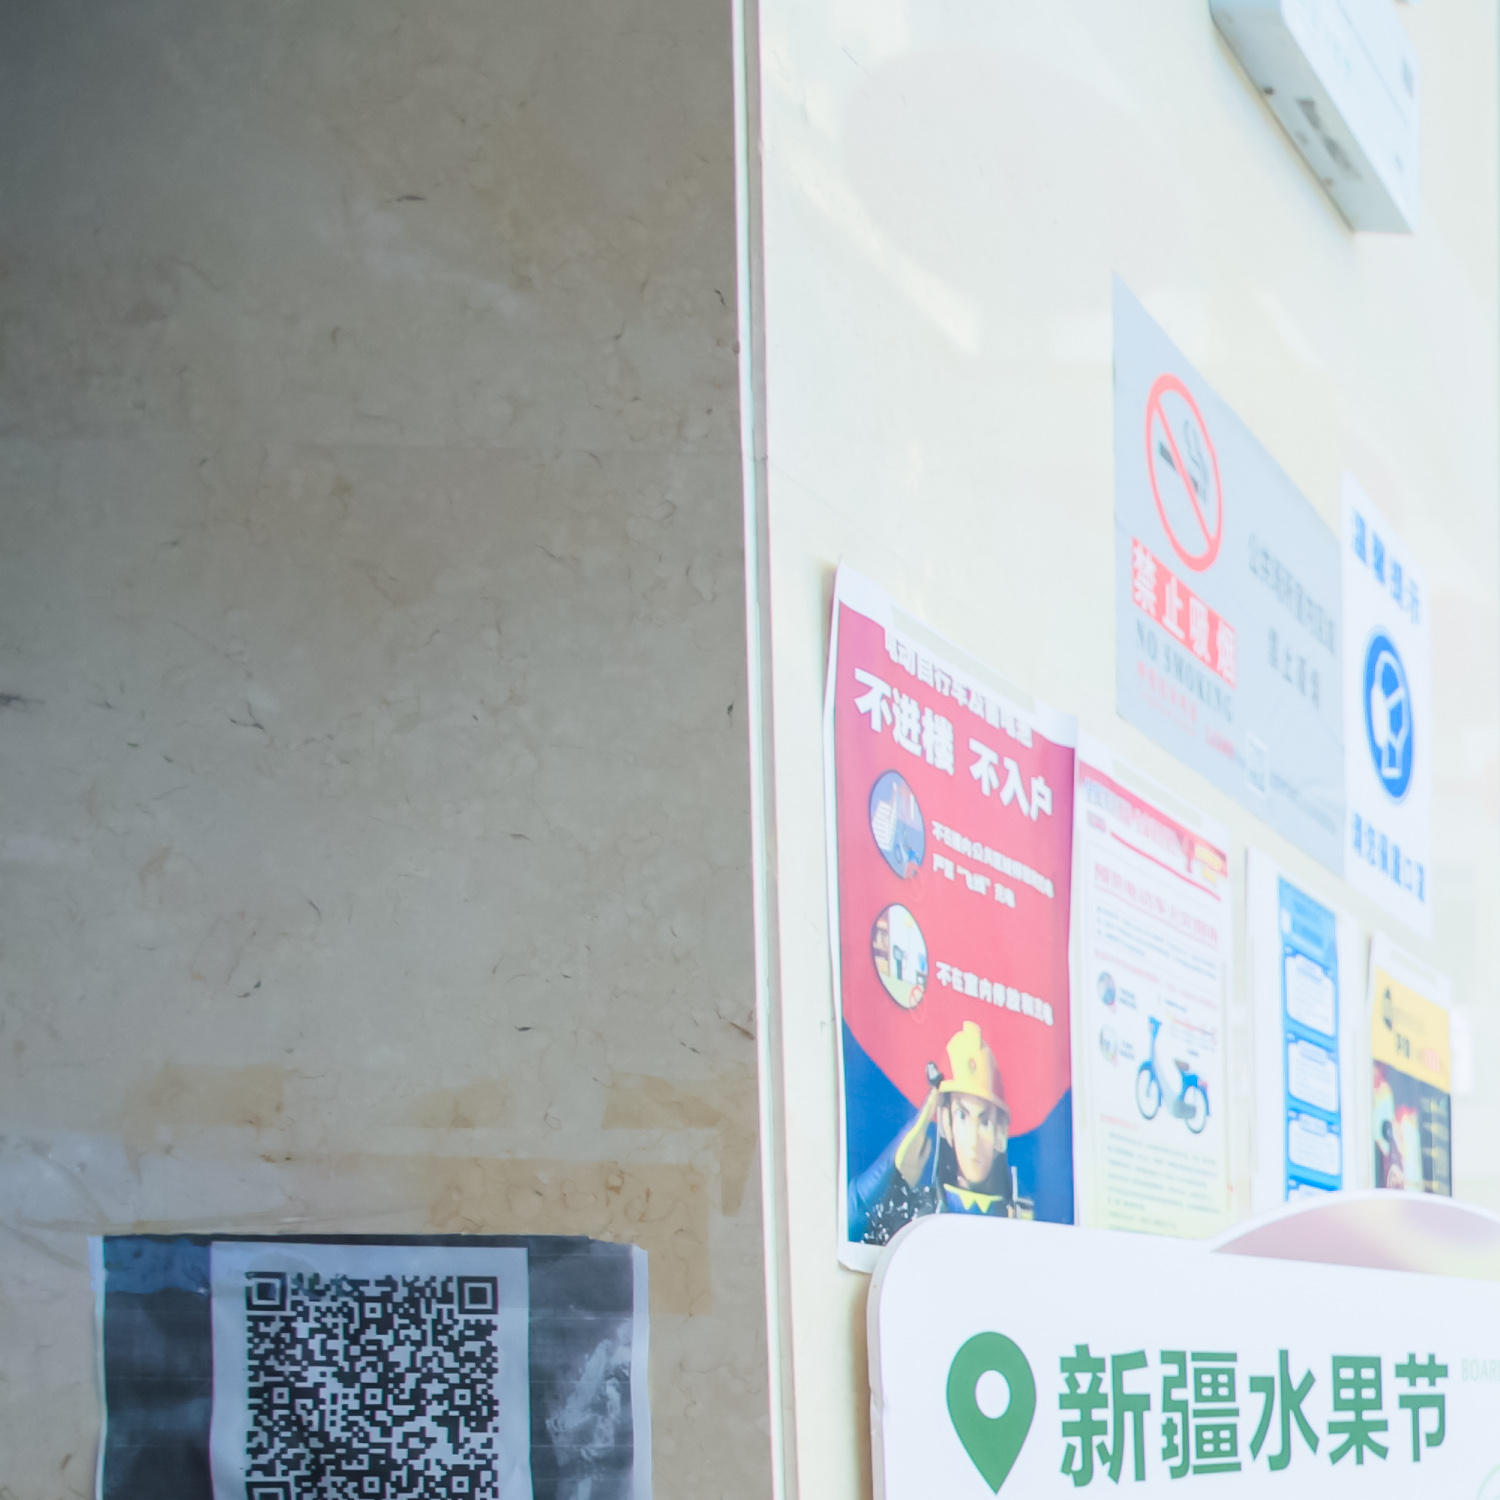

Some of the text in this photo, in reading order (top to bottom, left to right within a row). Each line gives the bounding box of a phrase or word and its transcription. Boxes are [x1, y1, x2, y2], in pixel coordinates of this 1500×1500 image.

[1133, 545, 1236, 683] 禁止吸烟
[1137, 618, 1157, 662] NO
[1164, 643, 1232, 723] SMOKING
[854, 667, 955, 776] 不进楼
[969, 737, 1053, 822] 不入户
[1058, 1343, 1448, 1487] 新疆水果节
